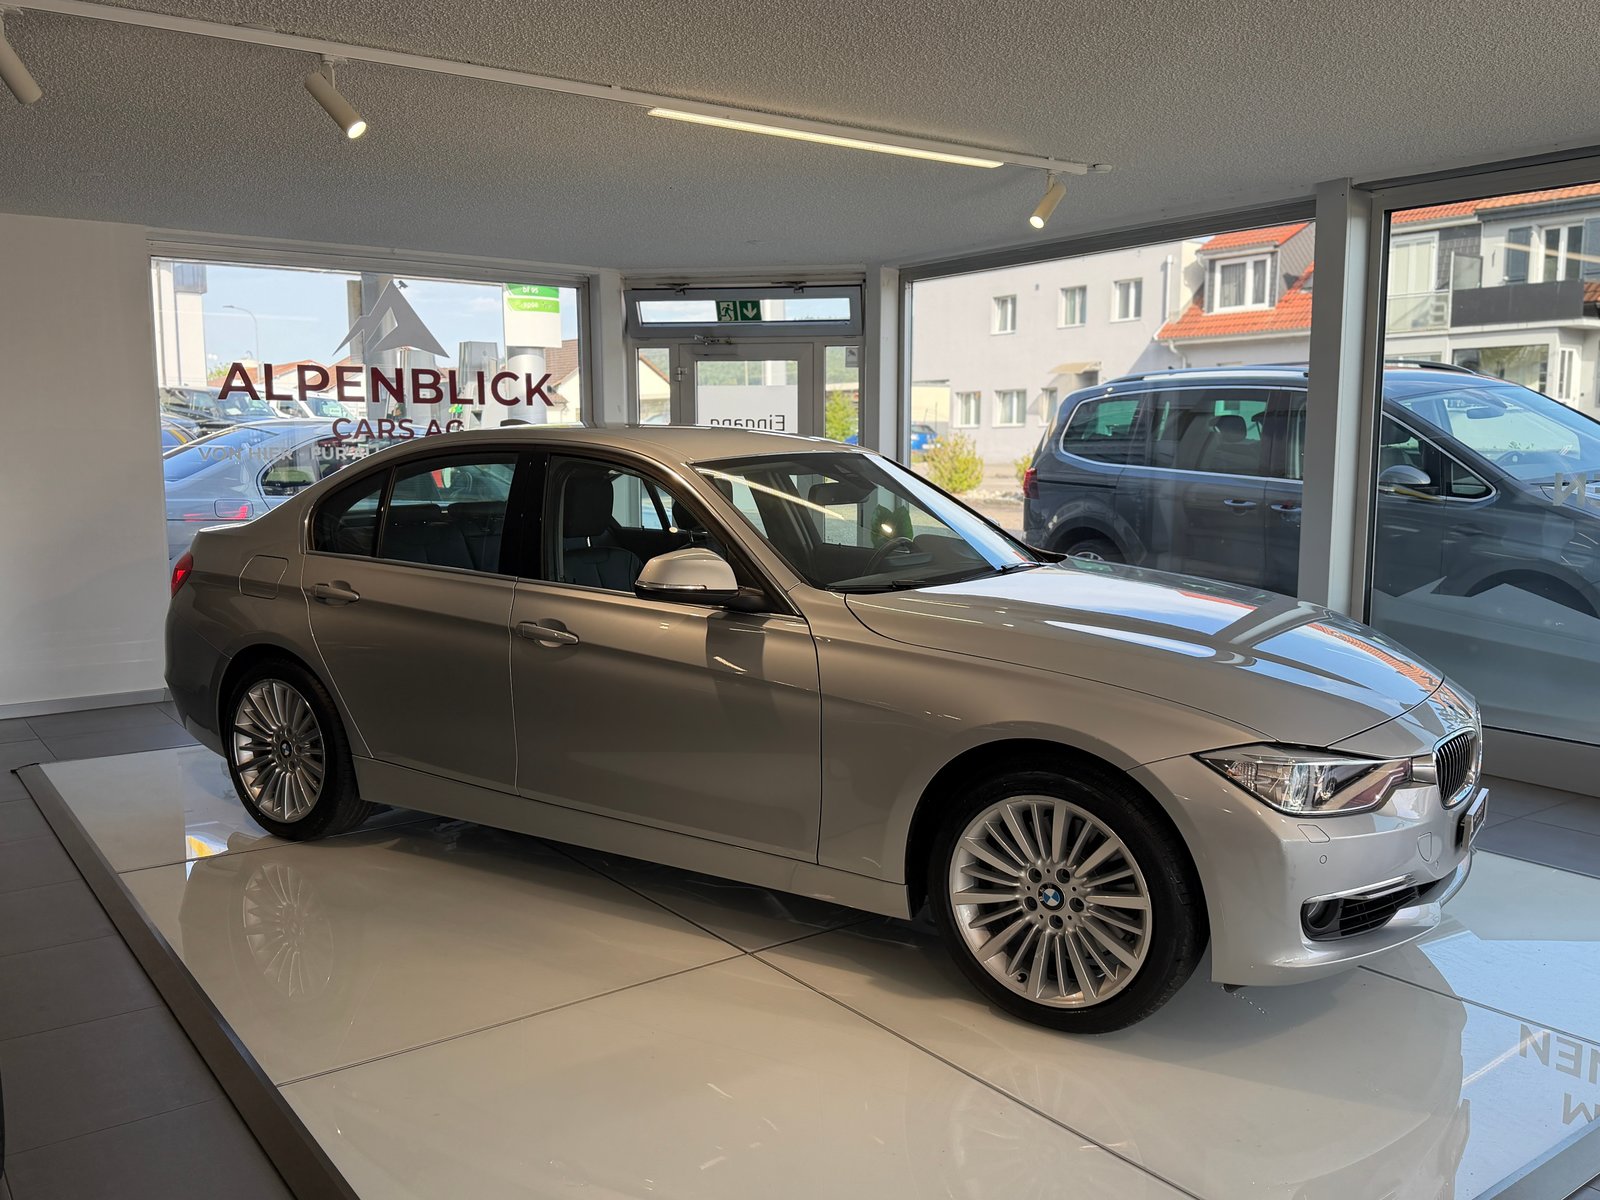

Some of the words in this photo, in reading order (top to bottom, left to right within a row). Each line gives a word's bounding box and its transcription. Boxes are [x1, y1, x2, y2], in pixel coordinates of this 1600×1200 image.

[218, 362, 554, 406] ALPENBLICK
[332, 418, 415, 440] CARS
[198, 447, 241, 461] VON
[249, 447, 293, 460] HIER
